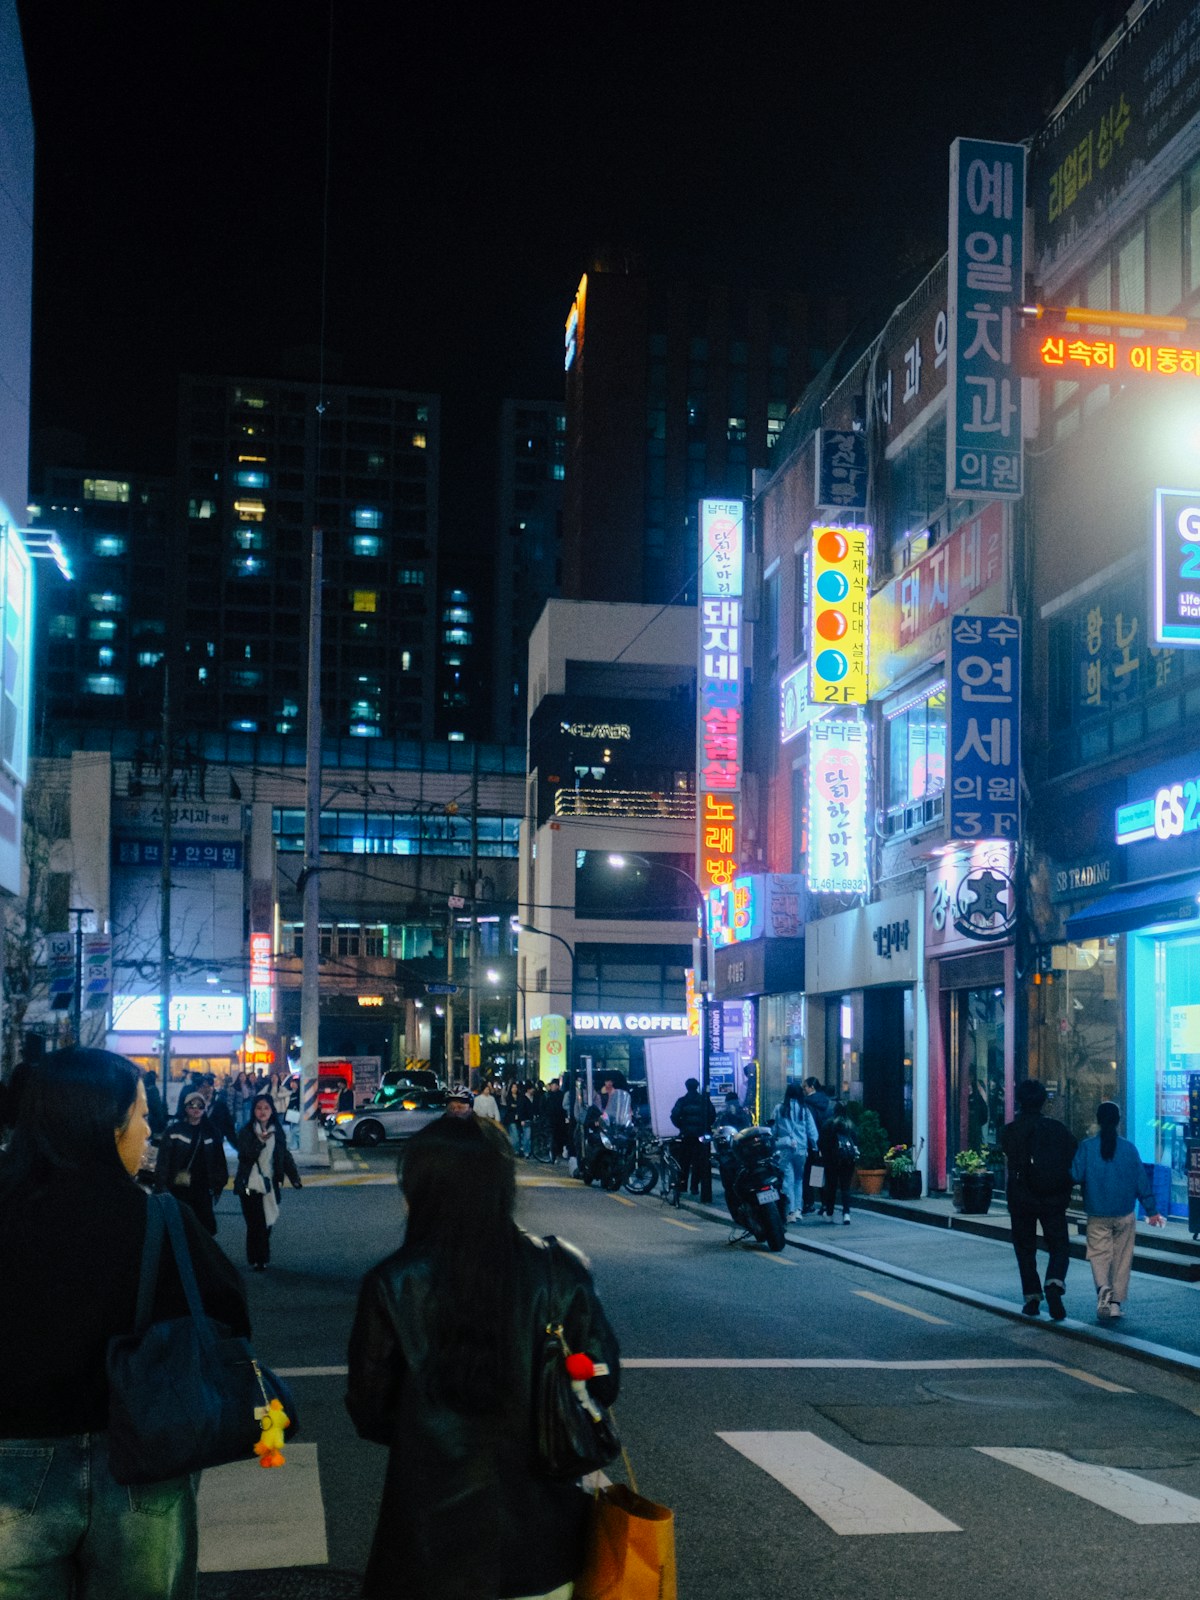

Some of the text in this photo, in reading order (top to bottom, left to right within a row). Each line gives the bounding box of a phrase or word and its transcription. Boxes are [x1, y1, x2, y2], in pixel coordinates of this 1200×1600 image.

[963, 159, 1018, 438] 예일치과
[1041, 337, 1115, 369] 신속히
[961, 453, 1018, 489] 의원
[708, 504, 738, 515] 남다른
[901, 518, 981, 634] 돼지네
[852, 541, 865, 676] 국제식 대대 설치
[703, 602, 739, 681] 돼지네
[954, 619, 1018, 645] 성수
[824, 685, 856, 702] 2F
[957, 655, 1012, 766] 연세
[701, 708, 740, 788] 삼겹살
[815, 725, 862, 742] 남다른
[954, 777, 1018, 801] 의원
[825, 769, 851, 868] 닭한마리
[955, 812, 1017, 831] 3F
[705, 792, 737, 886] 노래방
[1056, 861, 1111, 893] SB TRADING
[574, 1015, 622, 1029] EDIYA
[712, 1010, 720, 1035] UNION
